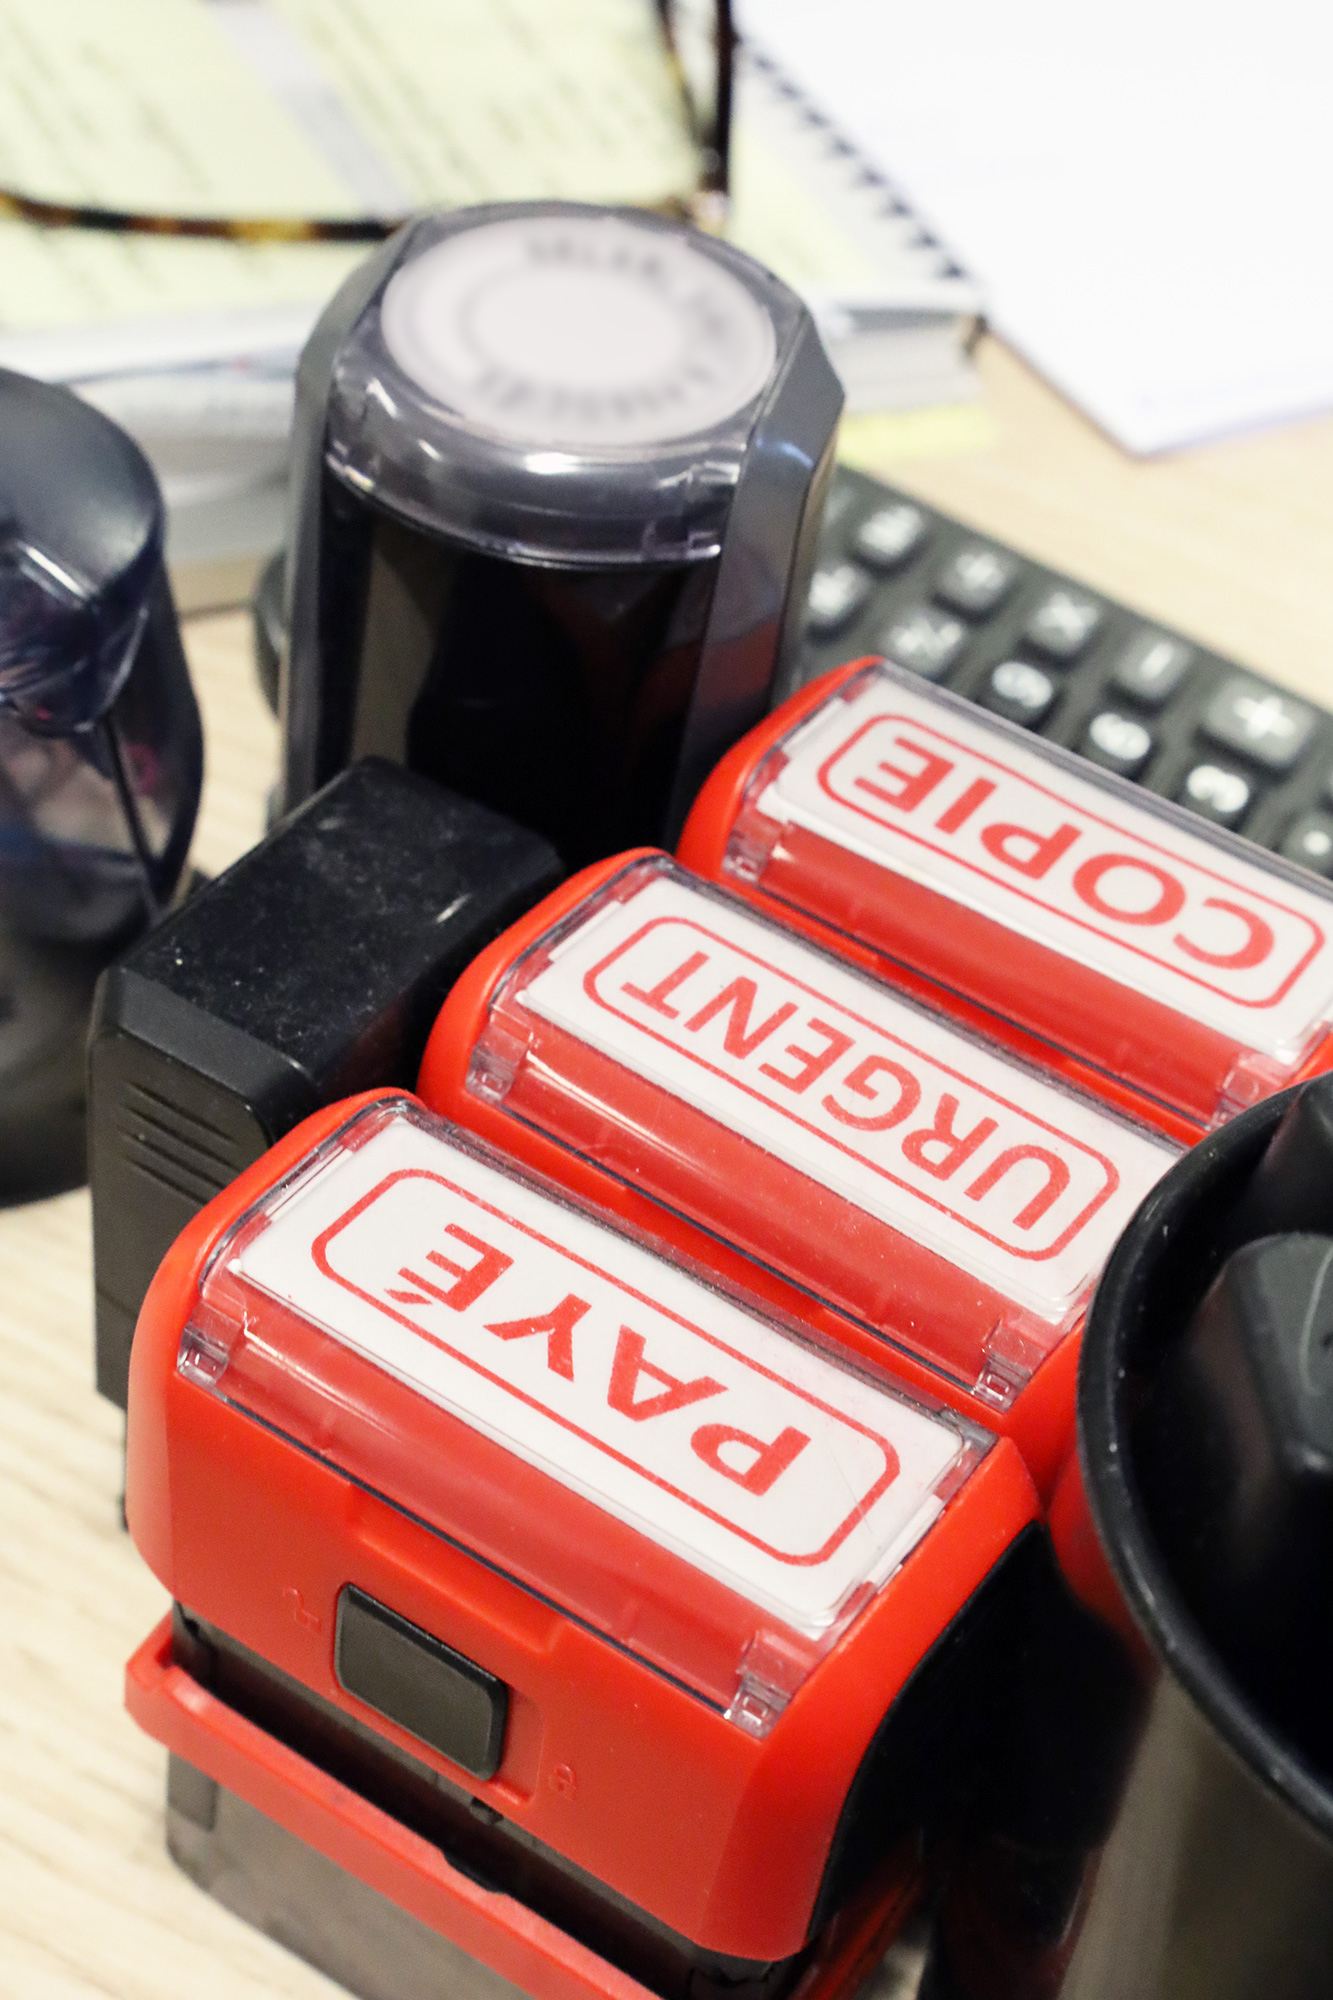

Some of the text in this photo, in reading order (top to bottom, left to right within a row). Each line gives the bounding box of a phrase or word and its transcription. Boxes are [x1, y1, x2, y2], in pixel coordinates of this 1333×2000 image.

[853, 736, 1275, 970] COPIE
[1186, 764, 1250, 814] 3
[620, 950, 1072, 1232] URGENT
[383, 1222, 813, 1498] PAYÉ
